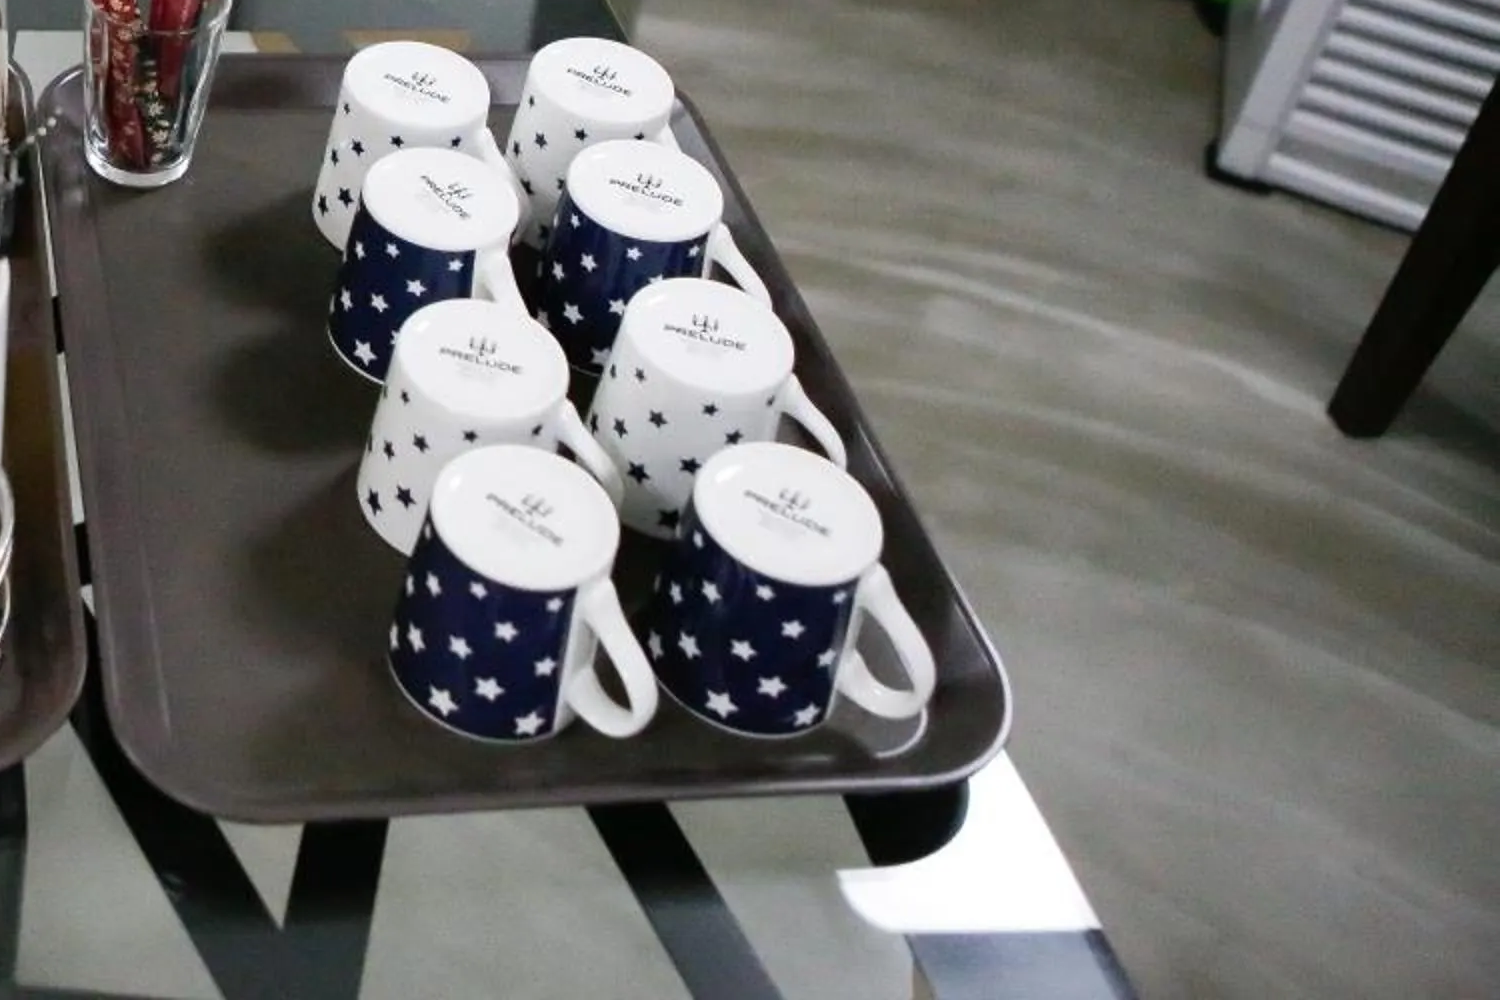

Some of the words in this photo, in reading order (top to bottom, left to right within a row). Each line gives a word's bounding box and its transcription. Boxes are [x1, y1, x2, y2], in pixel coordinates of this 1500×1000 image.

[383, 72, 452, 104] PRELUDE
[566, 66, 633, 98] PRELUDE
[420, 174, 471, 220] PRELUDE
[608, 177, 685, 208] PRELUDE
[662, 323, 748, 351] PRELUDE
[438, 346, 524, 375] PRELUDE
[485, 492, 565, 547] PRELUDE
[742, 488, 832, 538] PRELUDE
